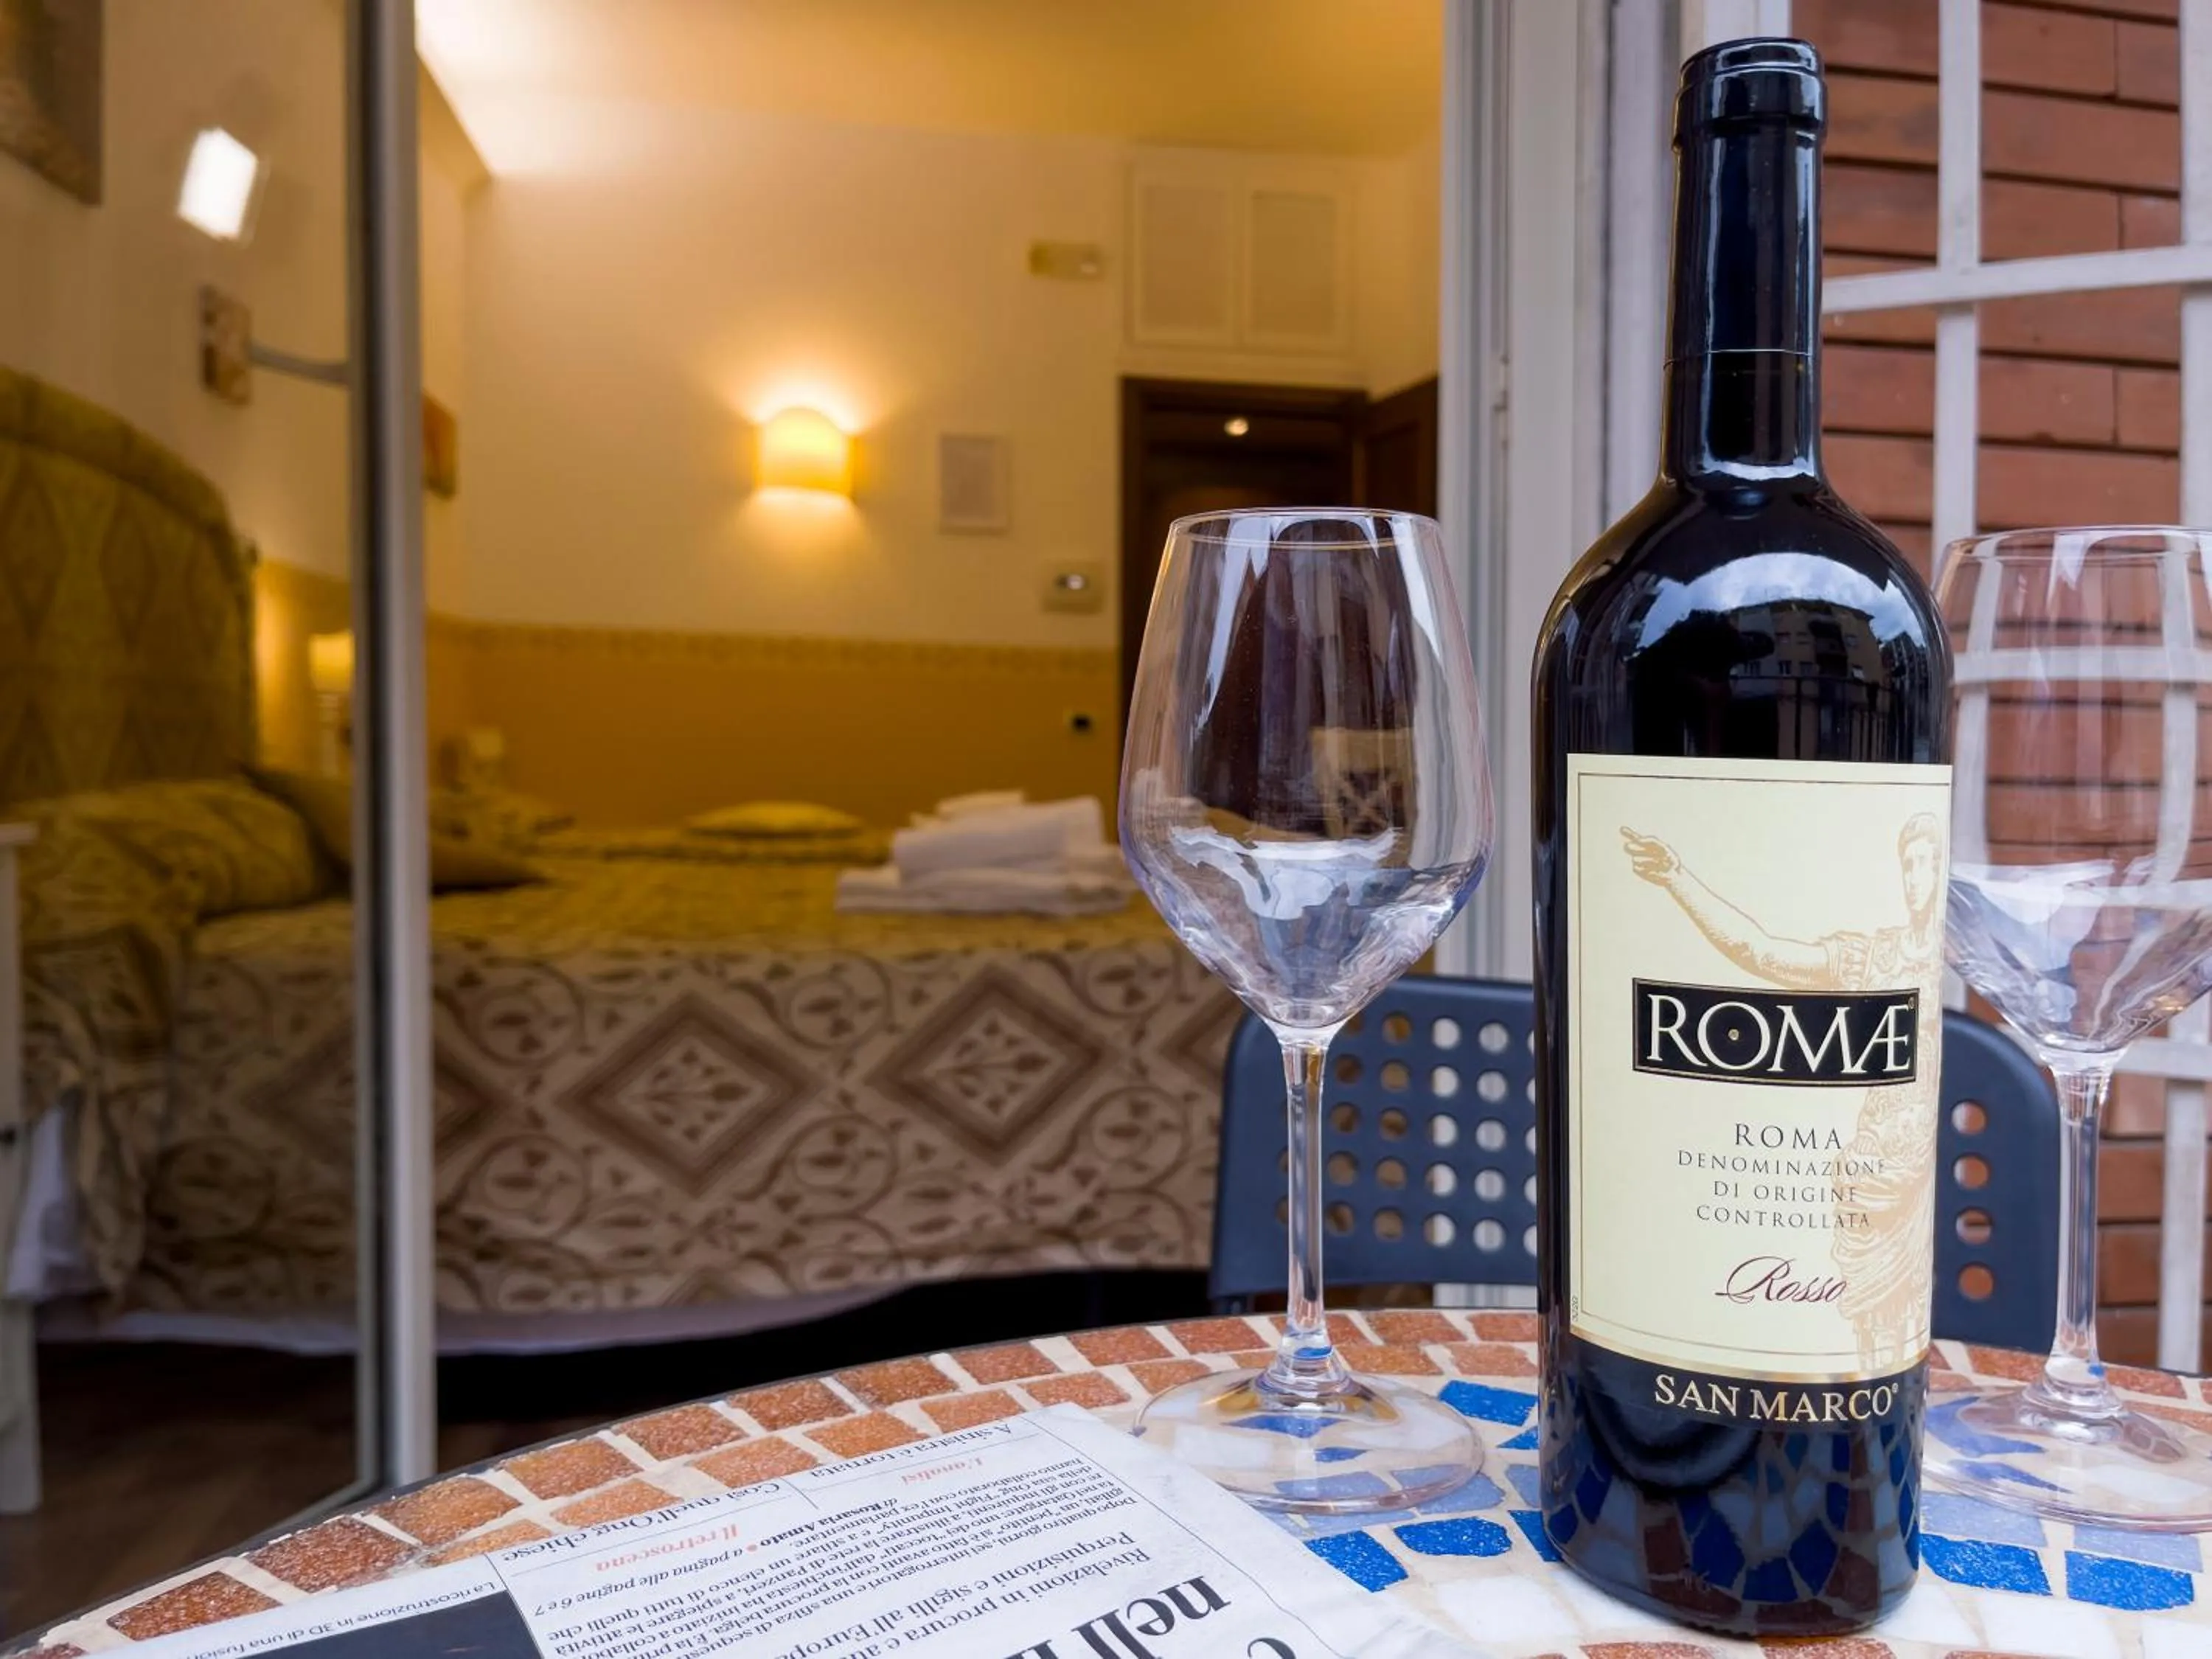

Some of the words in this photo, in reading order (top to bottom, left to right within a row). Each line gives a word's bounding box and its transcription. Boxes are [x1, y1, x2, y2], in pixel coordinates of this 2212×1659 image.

[1646, 994, 1911, 1074] ROMÆ
[1735, 1123, 1841, 1150] ROMA
[1677, 1150, 1885, 1176] DENOMINAZIONE
[1714, 1180, 1739, 1198] DI
[1753, 1185, 1857, 1203] ORIGINE
[1696, 1205, 1871, 1229] CONTROLLATA
[1714, 1256, 1848, 1304] Rosso
[1655, 1374, 1741, 1415] SAN
[914, 1429, 993, 1452] sinistra
[993, 1424, 1011, 1433] A
[810, 1453, 895, 1478] tornata
[817, 1503, 884, 1527] Rosaria
[883, 1498, 897, 1509] di
[591, 1498, 720, 1537] quell'Ong
[720, 1523, 737, 1540] Il
[760, 1522, 818, 1546] Amato
[501, 1534, 587, 1561] chiese
[594, 1531, 717, 1572] retroscena
[731, 1548, 742, 1557] a
[991, 1531, 1136, 1587] Perquisizioni
[672, 1551, 730, 1577] pagina
[1027, 1548, 1151, 1598] Rivelazioni
[473, 1582, 495, 1592] La
[576, 1578, 636, 1602] pagine
[639, 1571, 669, 1587] alle
[974, 1581, 989, 1593] e
[357, 1590, 471, 1621] ricostruzione
[549, 1601, 557, 1610] e
[561, 1598, 572, 1609] 6
[906, 1585, 973, 1618] sigilli
[999, 1590, 1030, 1604] in
[337, 1618, 353, 1627] in
[535, 1605, 545, 1616] 7
[903, 1597, 998, 1641] procura
[287, 1630, 304, 1640] di
[309, 1623, 333, 1635] 3D
[249, 1635, 283, 1648] una
[676, 1627, 754, 1659] sequest
[884, 1638, 900, 1649] e
